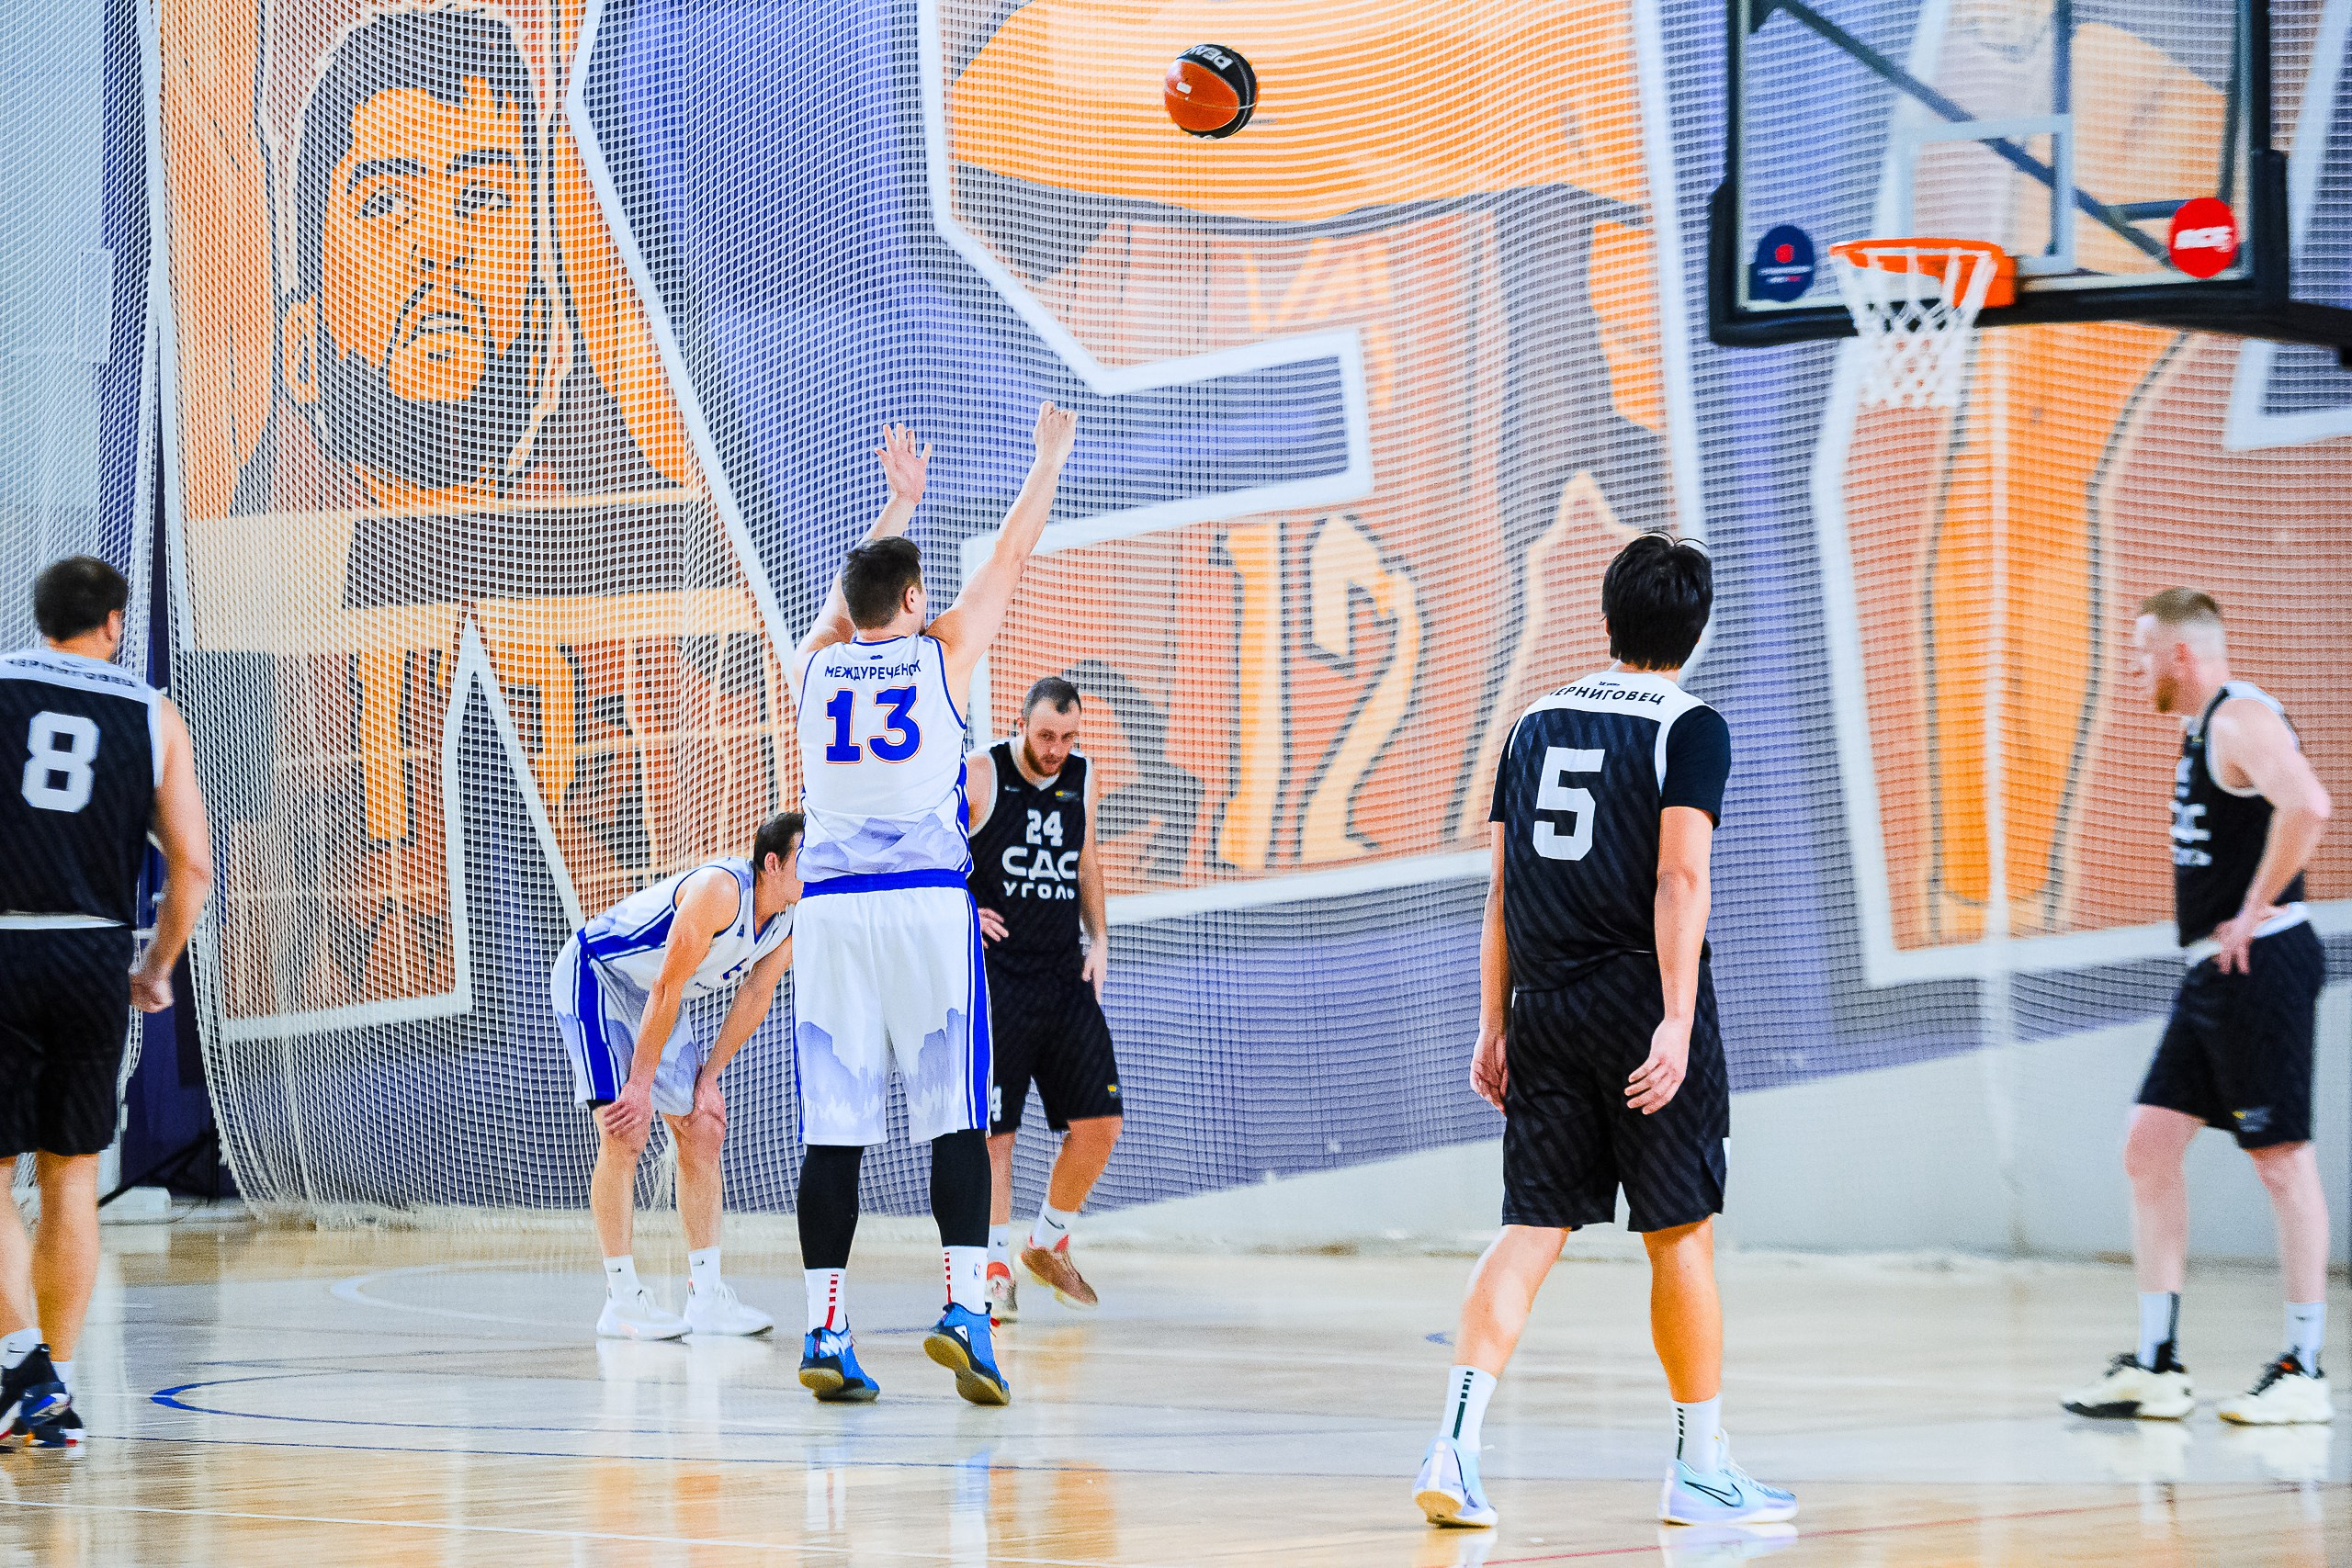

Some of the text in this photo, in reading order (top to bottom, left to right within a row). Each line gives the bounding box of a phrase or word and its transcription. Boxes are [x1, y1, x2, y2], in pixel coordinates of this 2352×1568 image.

[825, 683, 922, 765] 13
[1549, 686, 1666, 705] ЕРНИГОВЕЦ
[20, 710, 101, 814] 8
[1025, 808, 1064, 847] 24
[1532, 745, 1606, 862] 5
[1001, 845, 1080, 882] СДС
